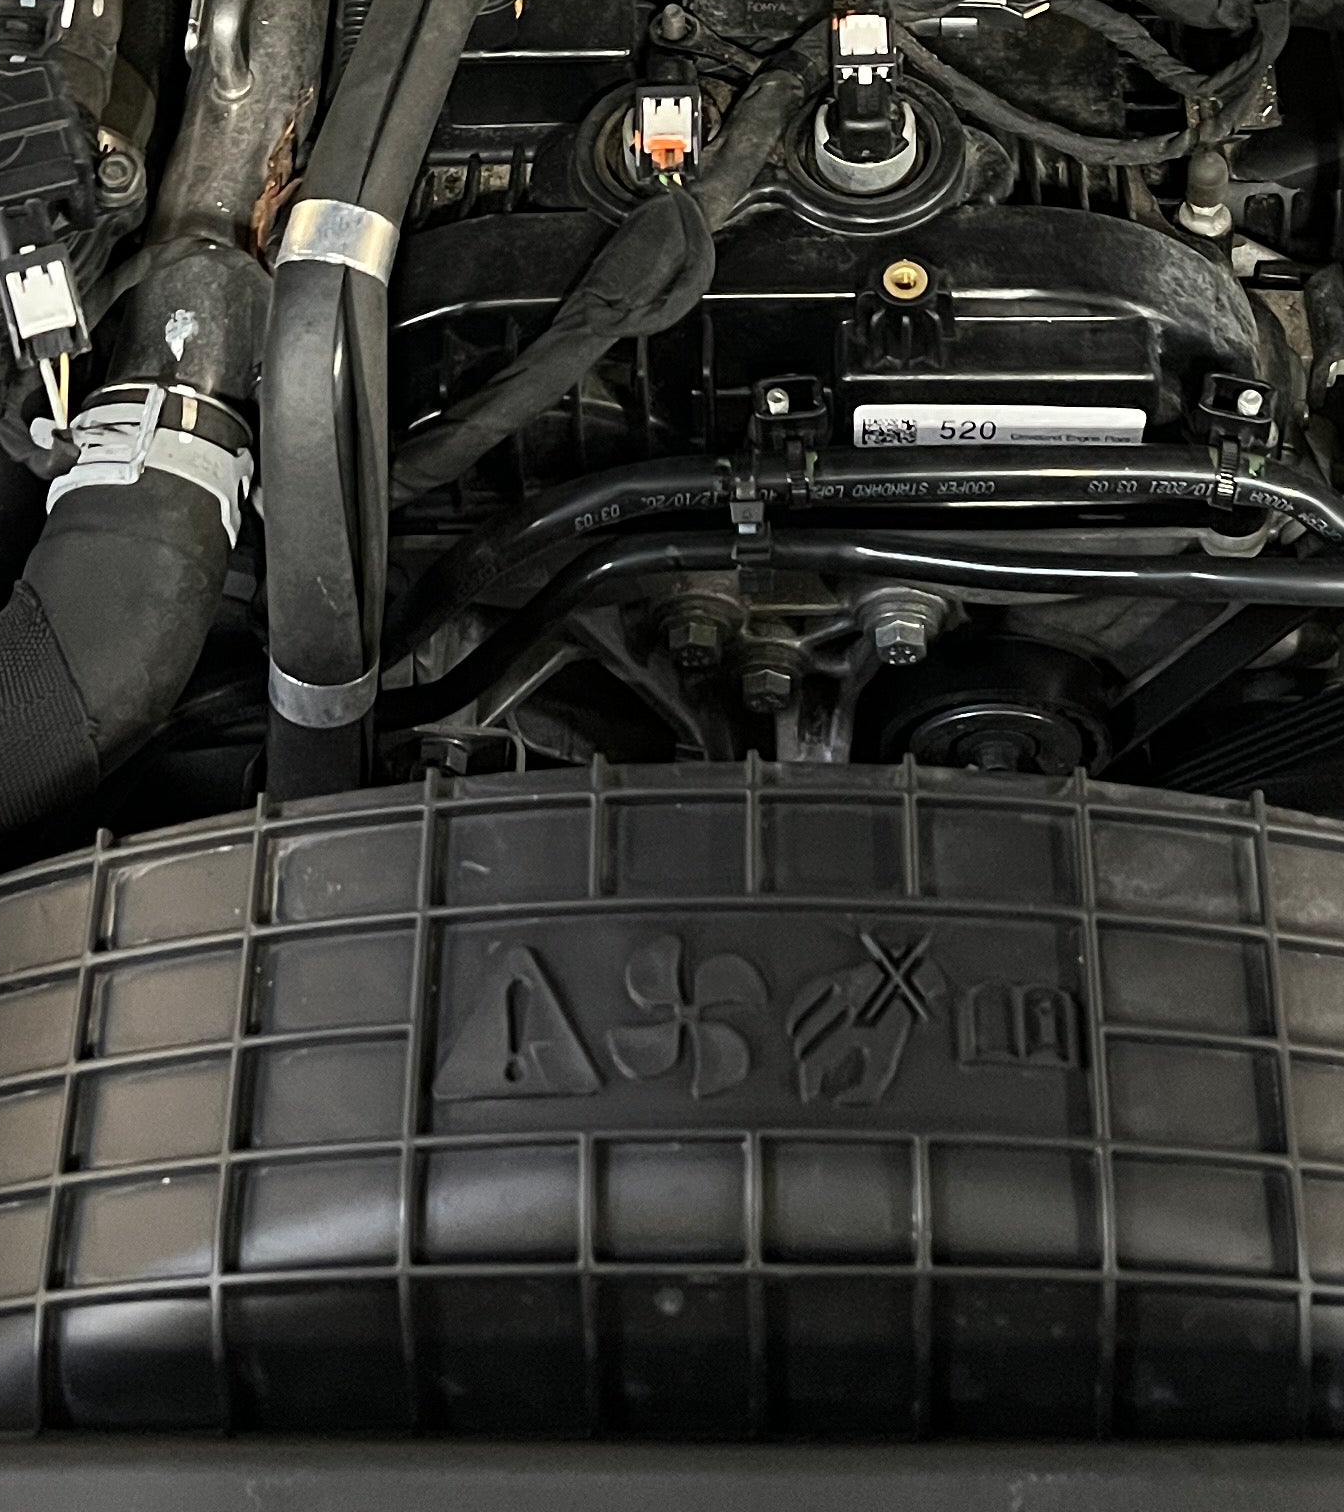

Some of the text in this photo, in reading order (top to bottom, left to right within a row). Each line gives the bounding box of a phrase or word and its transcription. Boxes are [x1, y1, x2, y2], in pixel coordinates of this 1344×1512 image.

[939, 420, 997, 440] 520
[852, 481, 929, 497] STANDARD
[937, 480, 996, 494] COOPER
